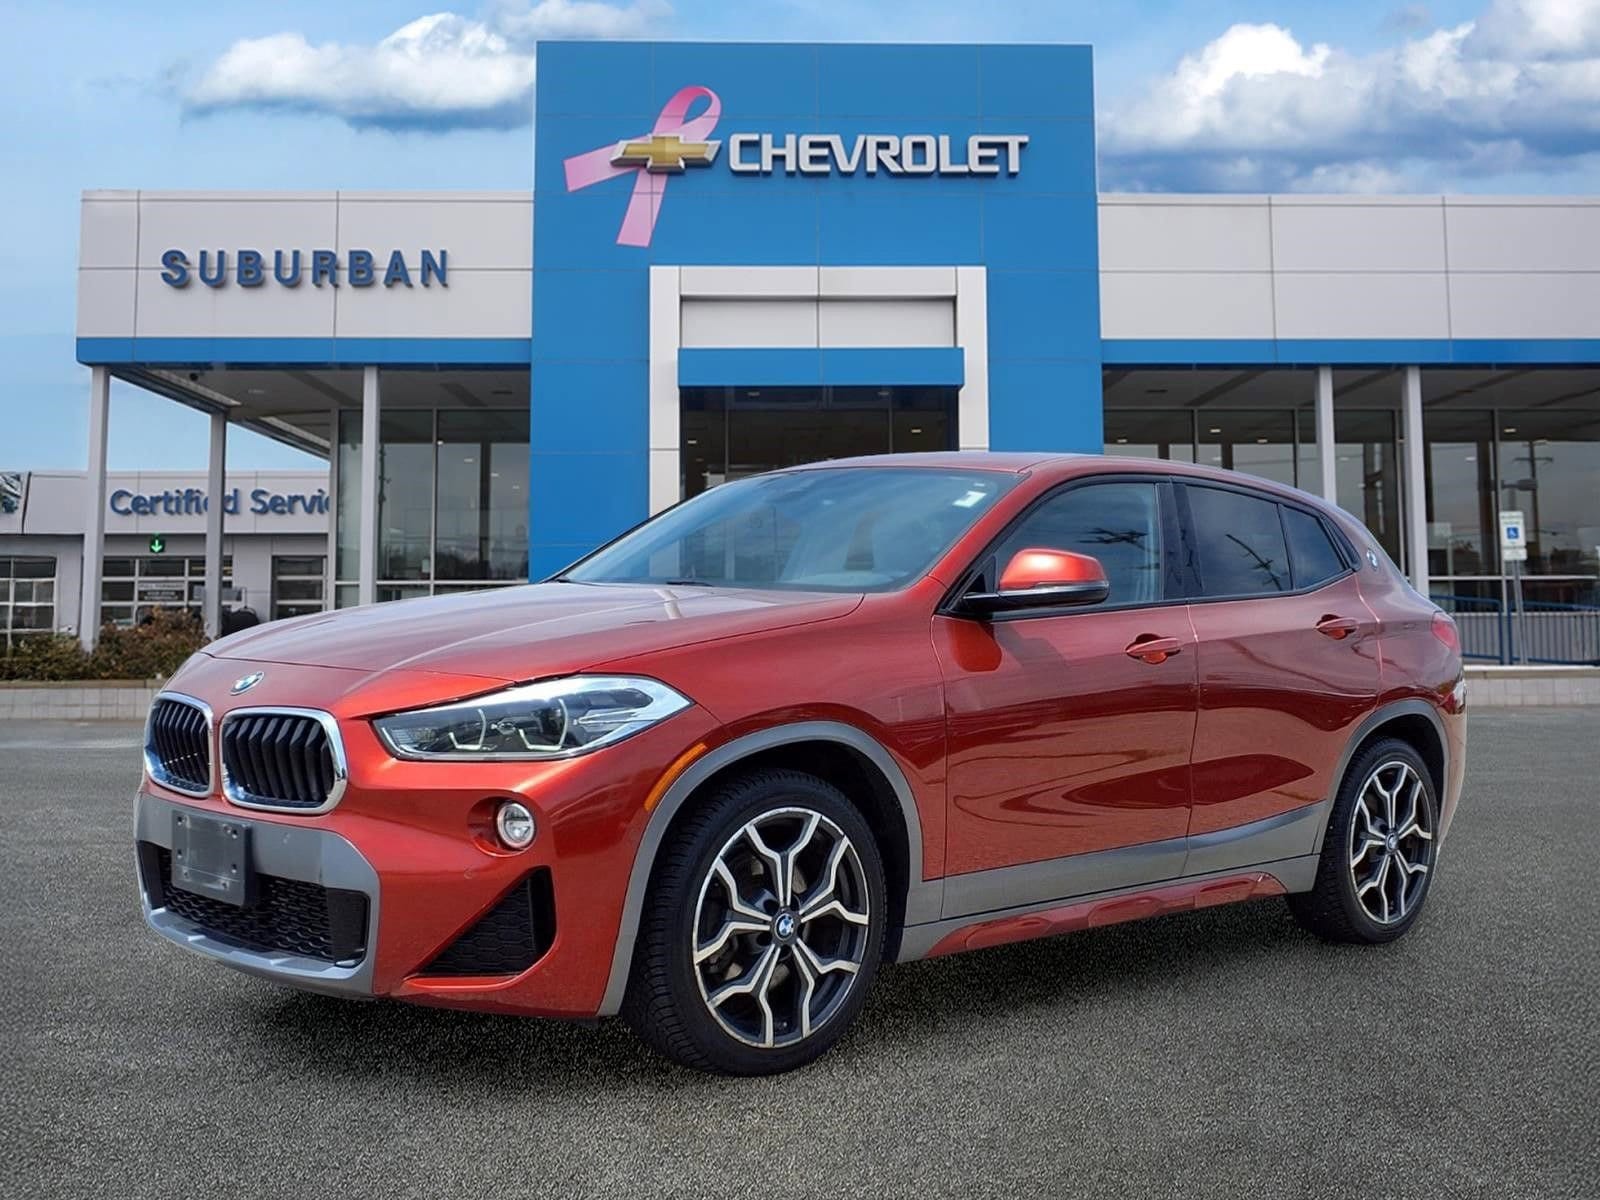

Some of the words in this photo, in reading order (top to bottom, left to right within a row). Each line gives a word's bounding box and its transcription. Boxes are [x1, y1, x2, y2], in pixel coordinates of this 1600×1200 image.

[729, 133, 1029, 175] CHEVROLET
[161, 249, 448, 287] SUBURBAN
[250, 488, 330, 515] Servi
